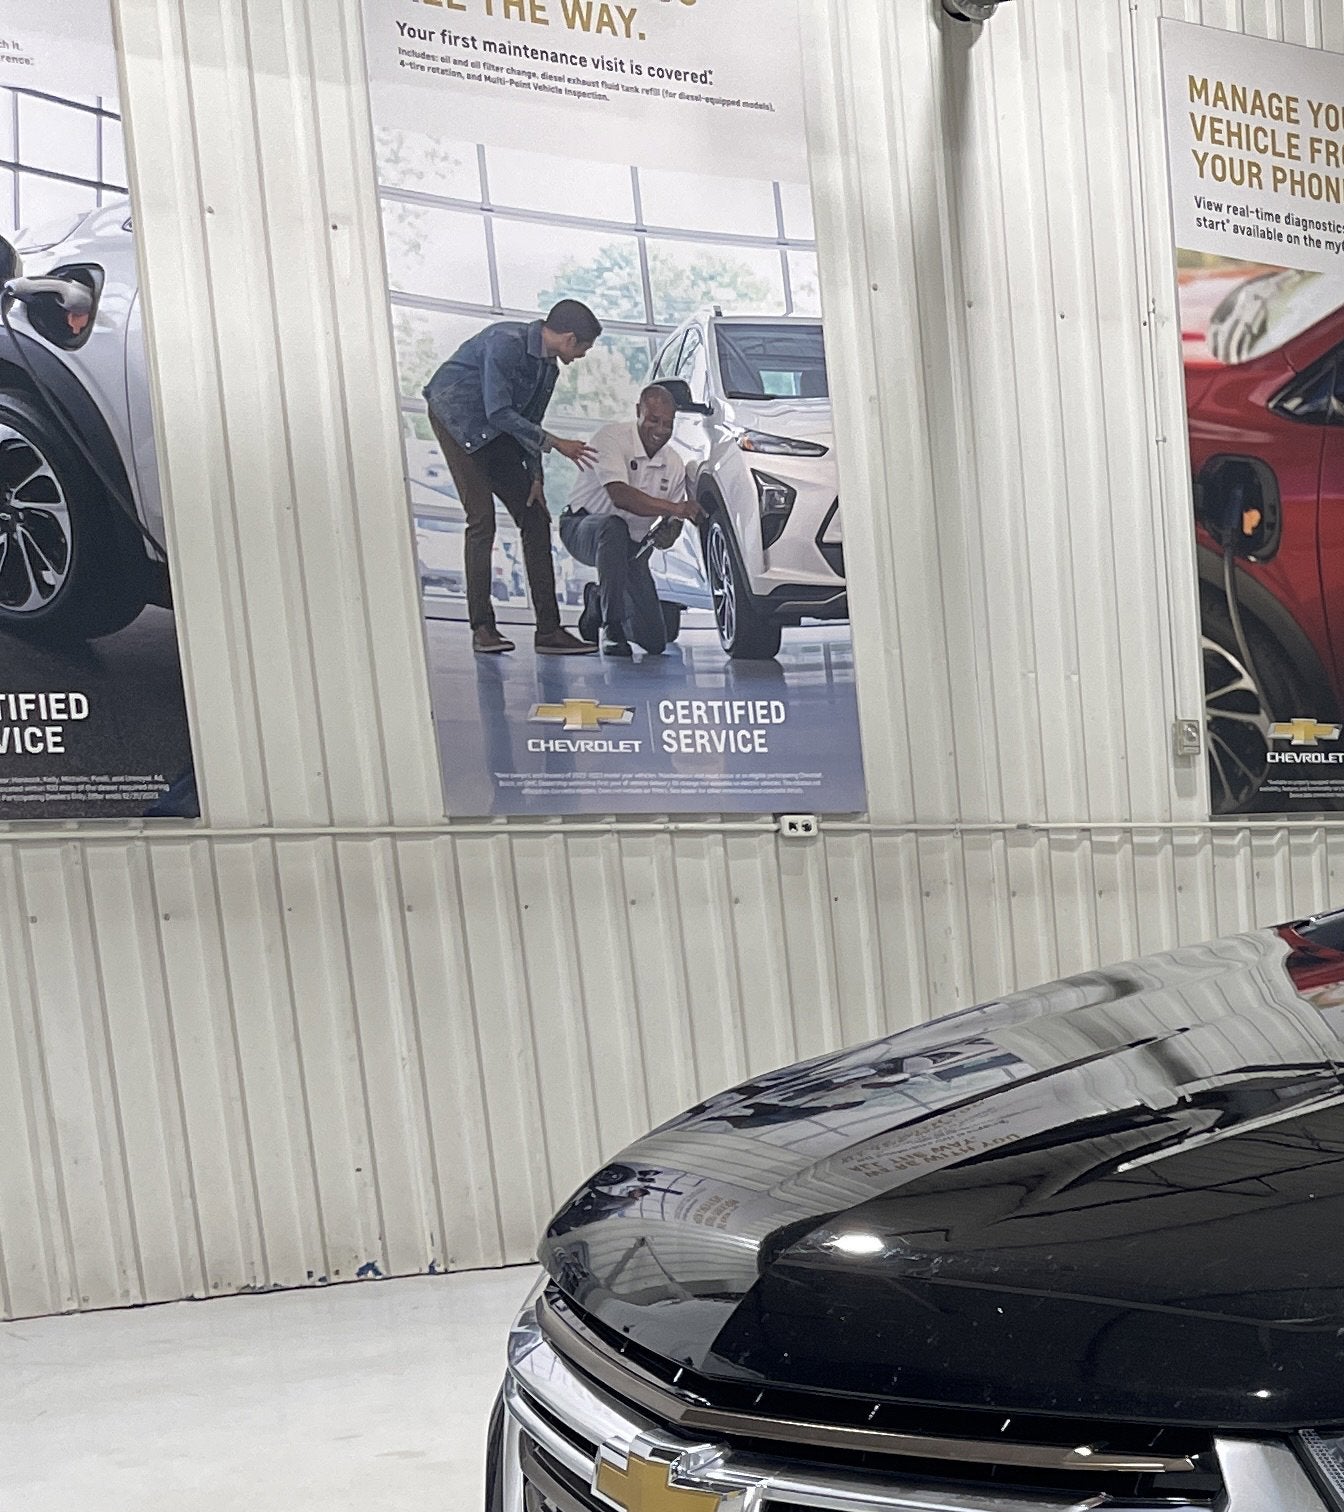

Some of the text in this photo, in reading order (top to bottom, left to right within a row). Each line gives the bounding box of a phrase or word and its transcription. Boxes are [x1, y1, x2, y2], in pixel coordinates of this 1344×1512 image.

[561, 0, 646, 41] WAY.
[396, 20, 435, 42] Your
[440, 29, 478, 50] first
[483, 38, 588, 68] maintenance
[591, 55, 626, 74] visit
[630, 59, 643, 76] is
[1187, 74, 1300, 126] MANAGE
[1188, 111, 1301, 161] VEHICLE
[1191, 149, 1263, 190] YOUR
[1193, 195, 1224, 214] View
[1226, 203, 1282, 225] real-time
[1232, 223, 1284, 243] available
[1286, 233, 1300, 245] on
[1303, 234, 1322, 249] the
[658, 700, 786, 725] CERTIFIED
[527, 739, 643, 753] CHEVROLET
[661, 729, 769, 753] SERVICE
[1267, 752, 1344, 764] CHEVROLET
